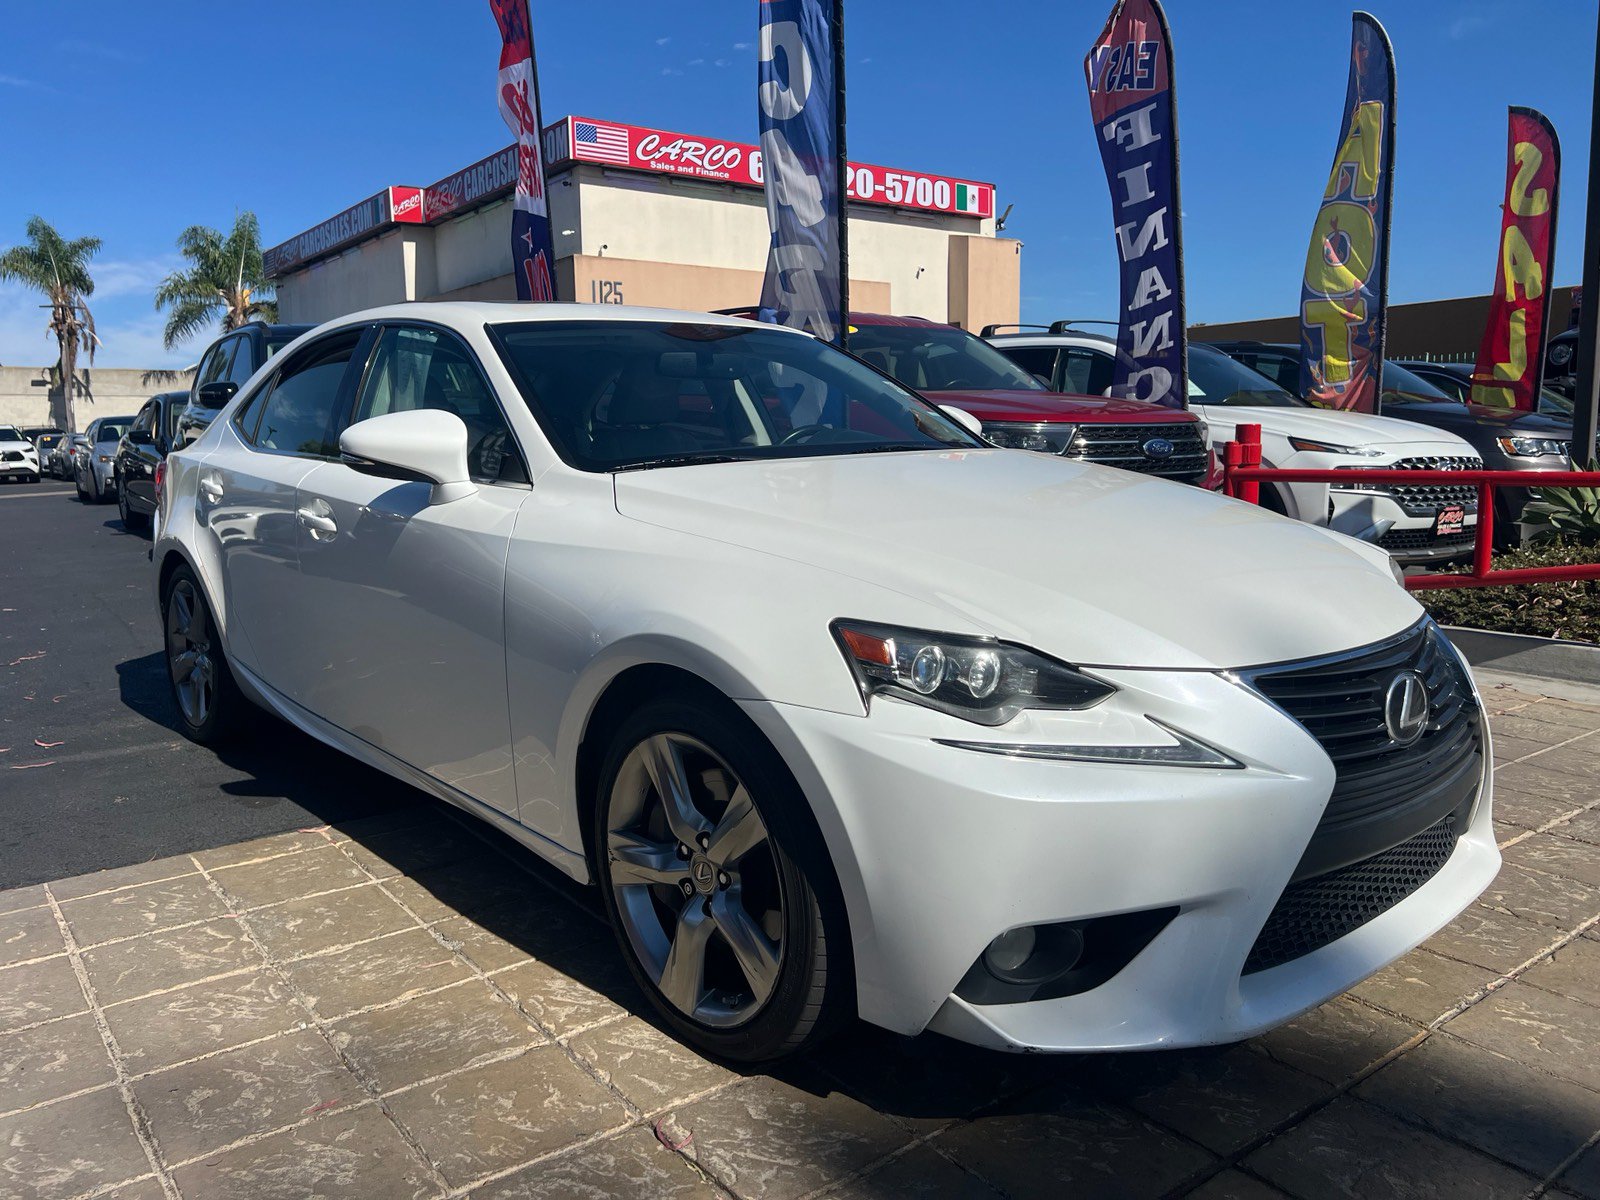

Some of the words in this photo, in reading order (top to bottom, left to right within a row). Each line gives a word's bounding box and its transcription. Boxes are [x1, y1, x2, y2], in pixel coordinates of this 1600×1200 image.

[635, 134, 742, 170] CARCO
[649, 161, 676, 170] Sales
[677, 165, 694, 174] and
[695, 168, 730, 180] Finance
[393, 194, 420, 215] CARCO
[299, 200, 374, 259] CARCOSALES.COM
[591, 279, 624, 305] 1125
